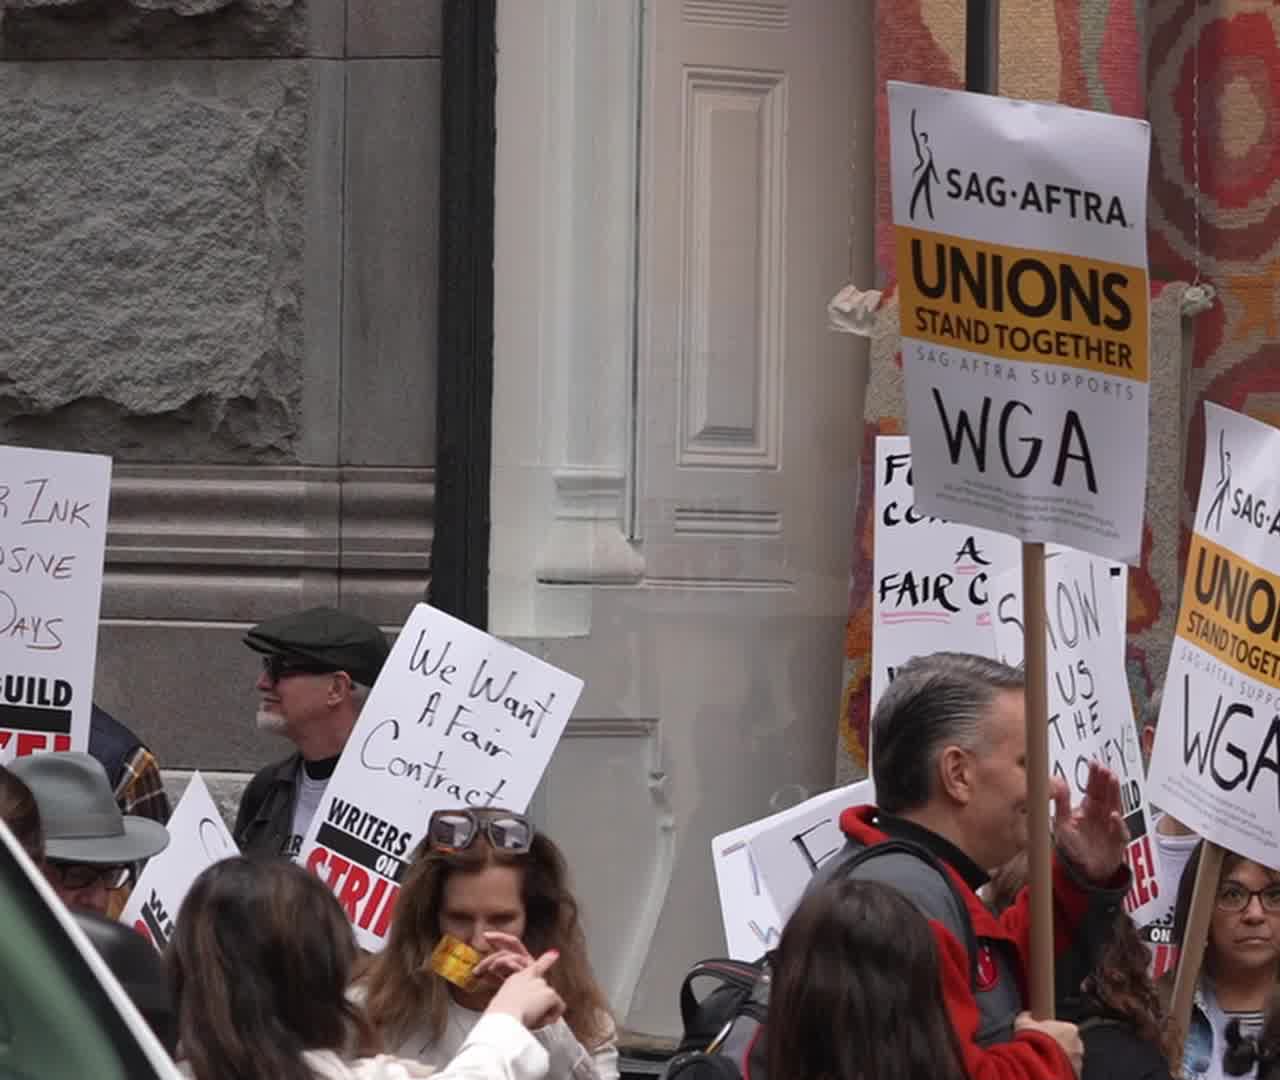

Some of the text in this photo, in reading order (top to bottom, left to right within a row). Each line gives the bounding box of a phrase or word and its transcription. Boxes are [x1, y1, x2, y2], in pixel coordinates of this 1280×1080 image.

[911, 239, 1132, 331] UNIONS
[915, 305, 1133, 369] STAND TOGETHER
[1031, 367, 1134, 401] SUPPORTS
[933, 386, 1098, 494] WGA
[22, 479, 91, 528] INK
[953, 536, 992, 565] A
[879, 570, 961, 613] FAIR
[1186, 609, 1230, 654] STAND
[0, 675, 73, 707] UILD
[408, 628, 556, 739] We Want
[1056, 658, 1095, 707] US
[417, 691, 513, 759] A Fair
[1048, 701, 1102, 751] THE
[360, 719, 507, 809] Contract
[327, 797, 413, 857] WRITERS
[375, 855, 400, 876] ON
[1150, 927, 1171, 942] ON
